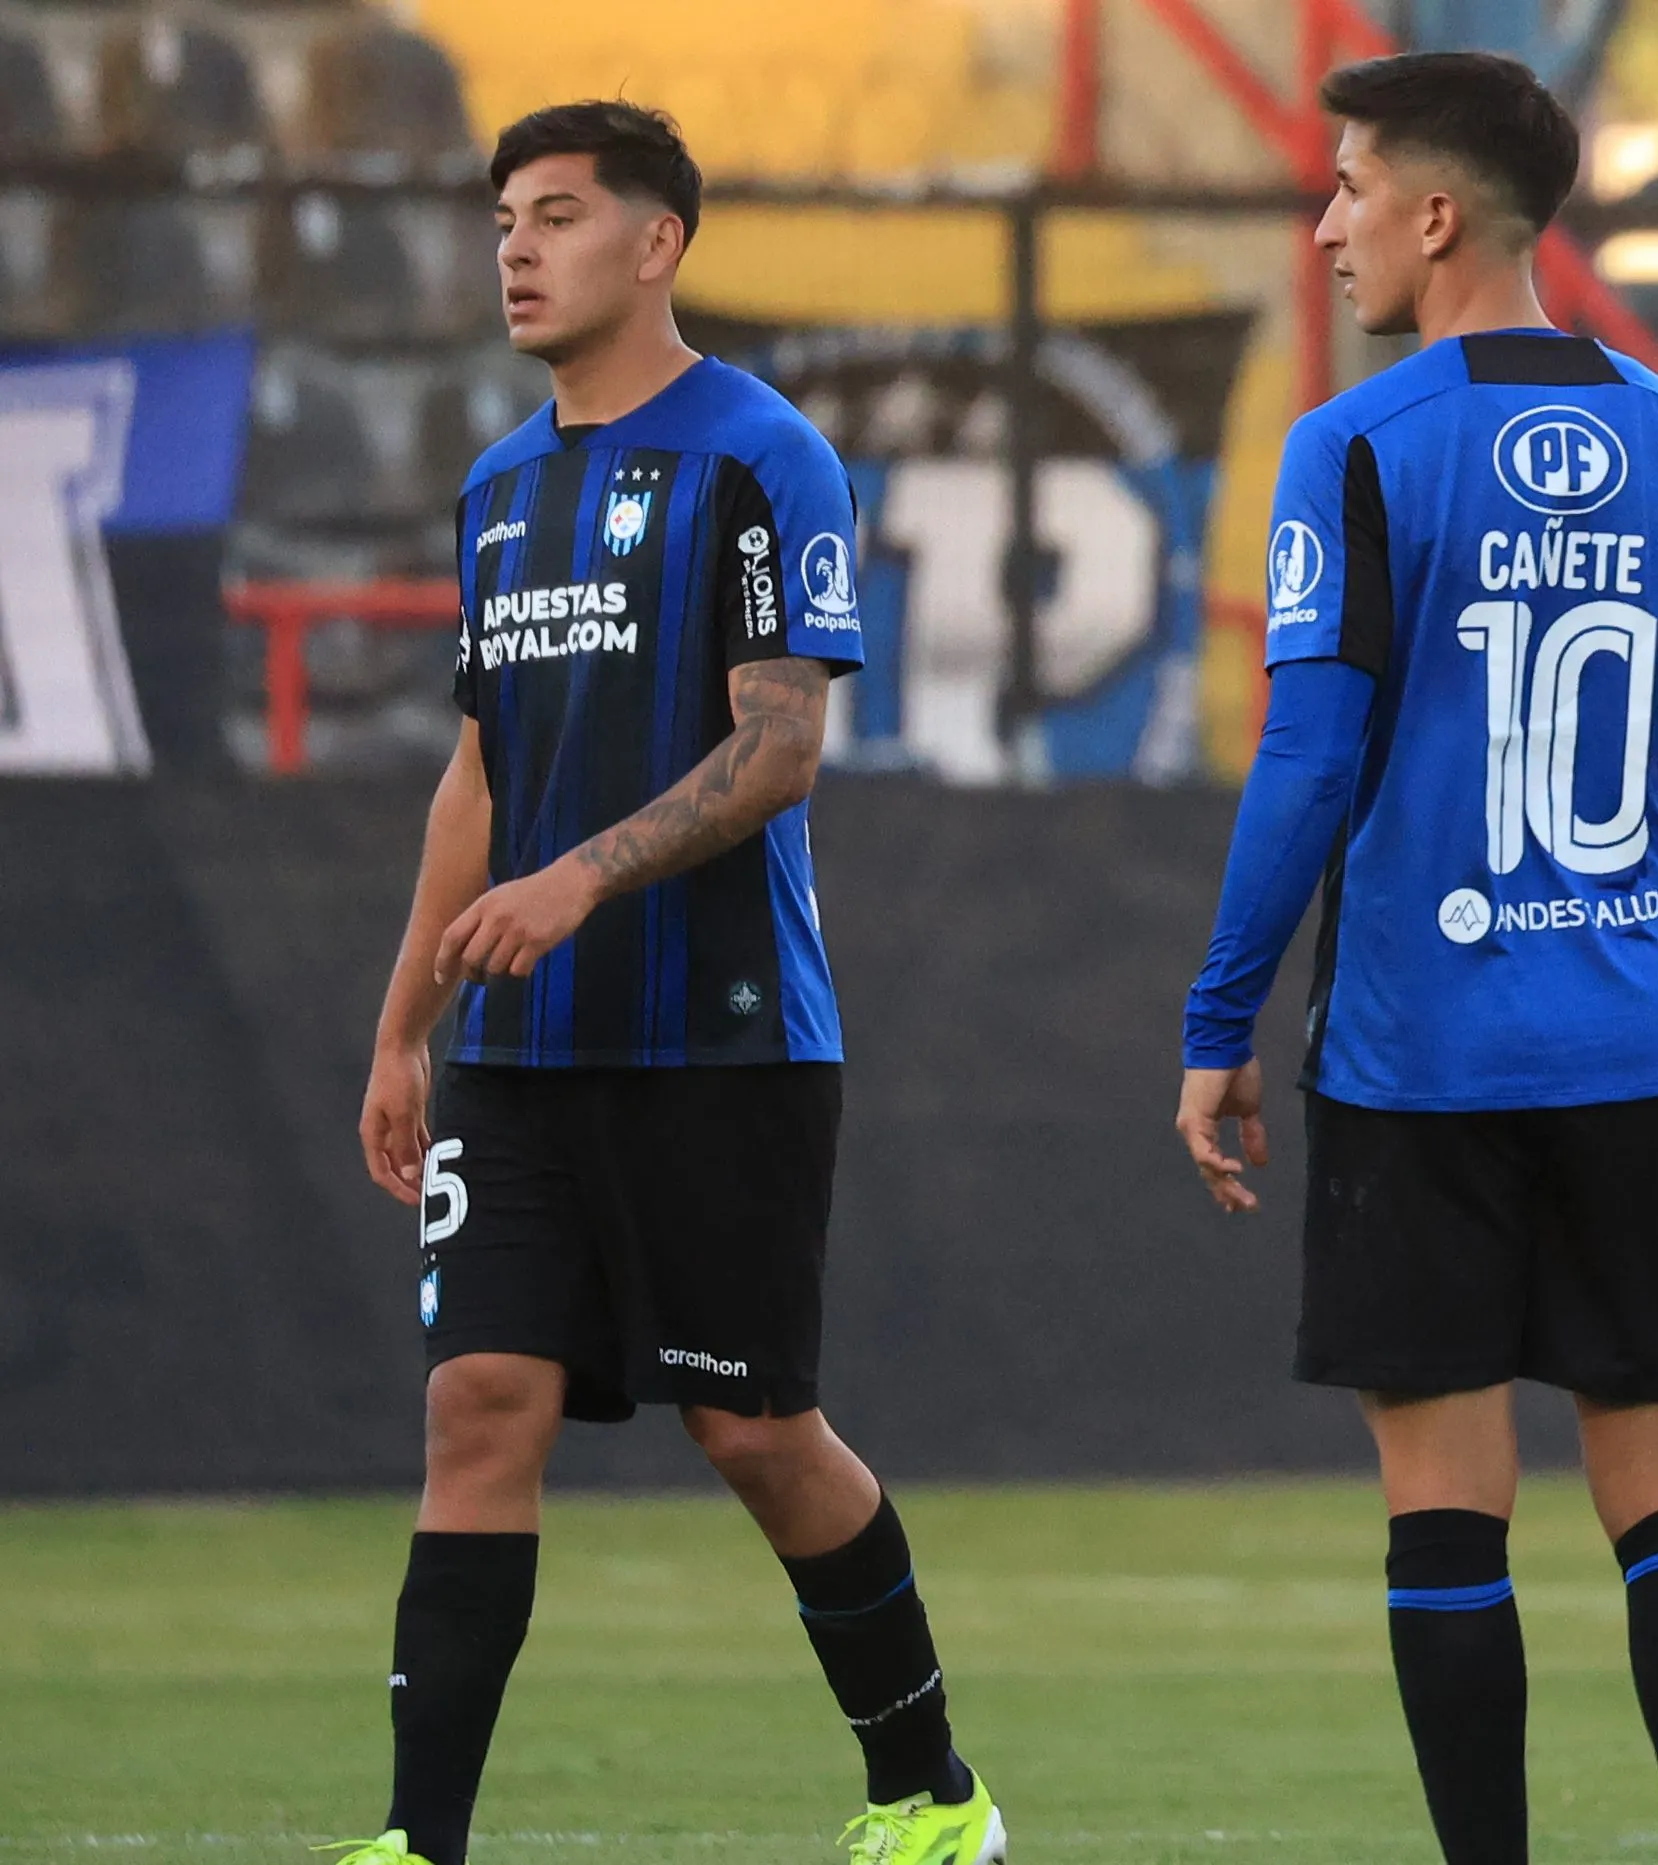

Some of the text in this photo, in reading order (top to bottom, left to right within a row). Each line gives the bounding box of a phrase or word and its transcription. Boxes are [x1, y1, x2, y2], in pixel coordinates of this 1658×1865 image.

[1528, 426, 1592, 492] PF
[1480, 516, 1645, 594] CAÑETE
[483, 582, 627, 632] APUESTAS
[752, 549, 777, 636] LIONS
[479, 621, 637, 671] ROYAL.COM
[804, 612, 861, 633] Polpaic
[1456, 600, 1658, 875] 10
[1494, 898, 1586, 932] ANDES
